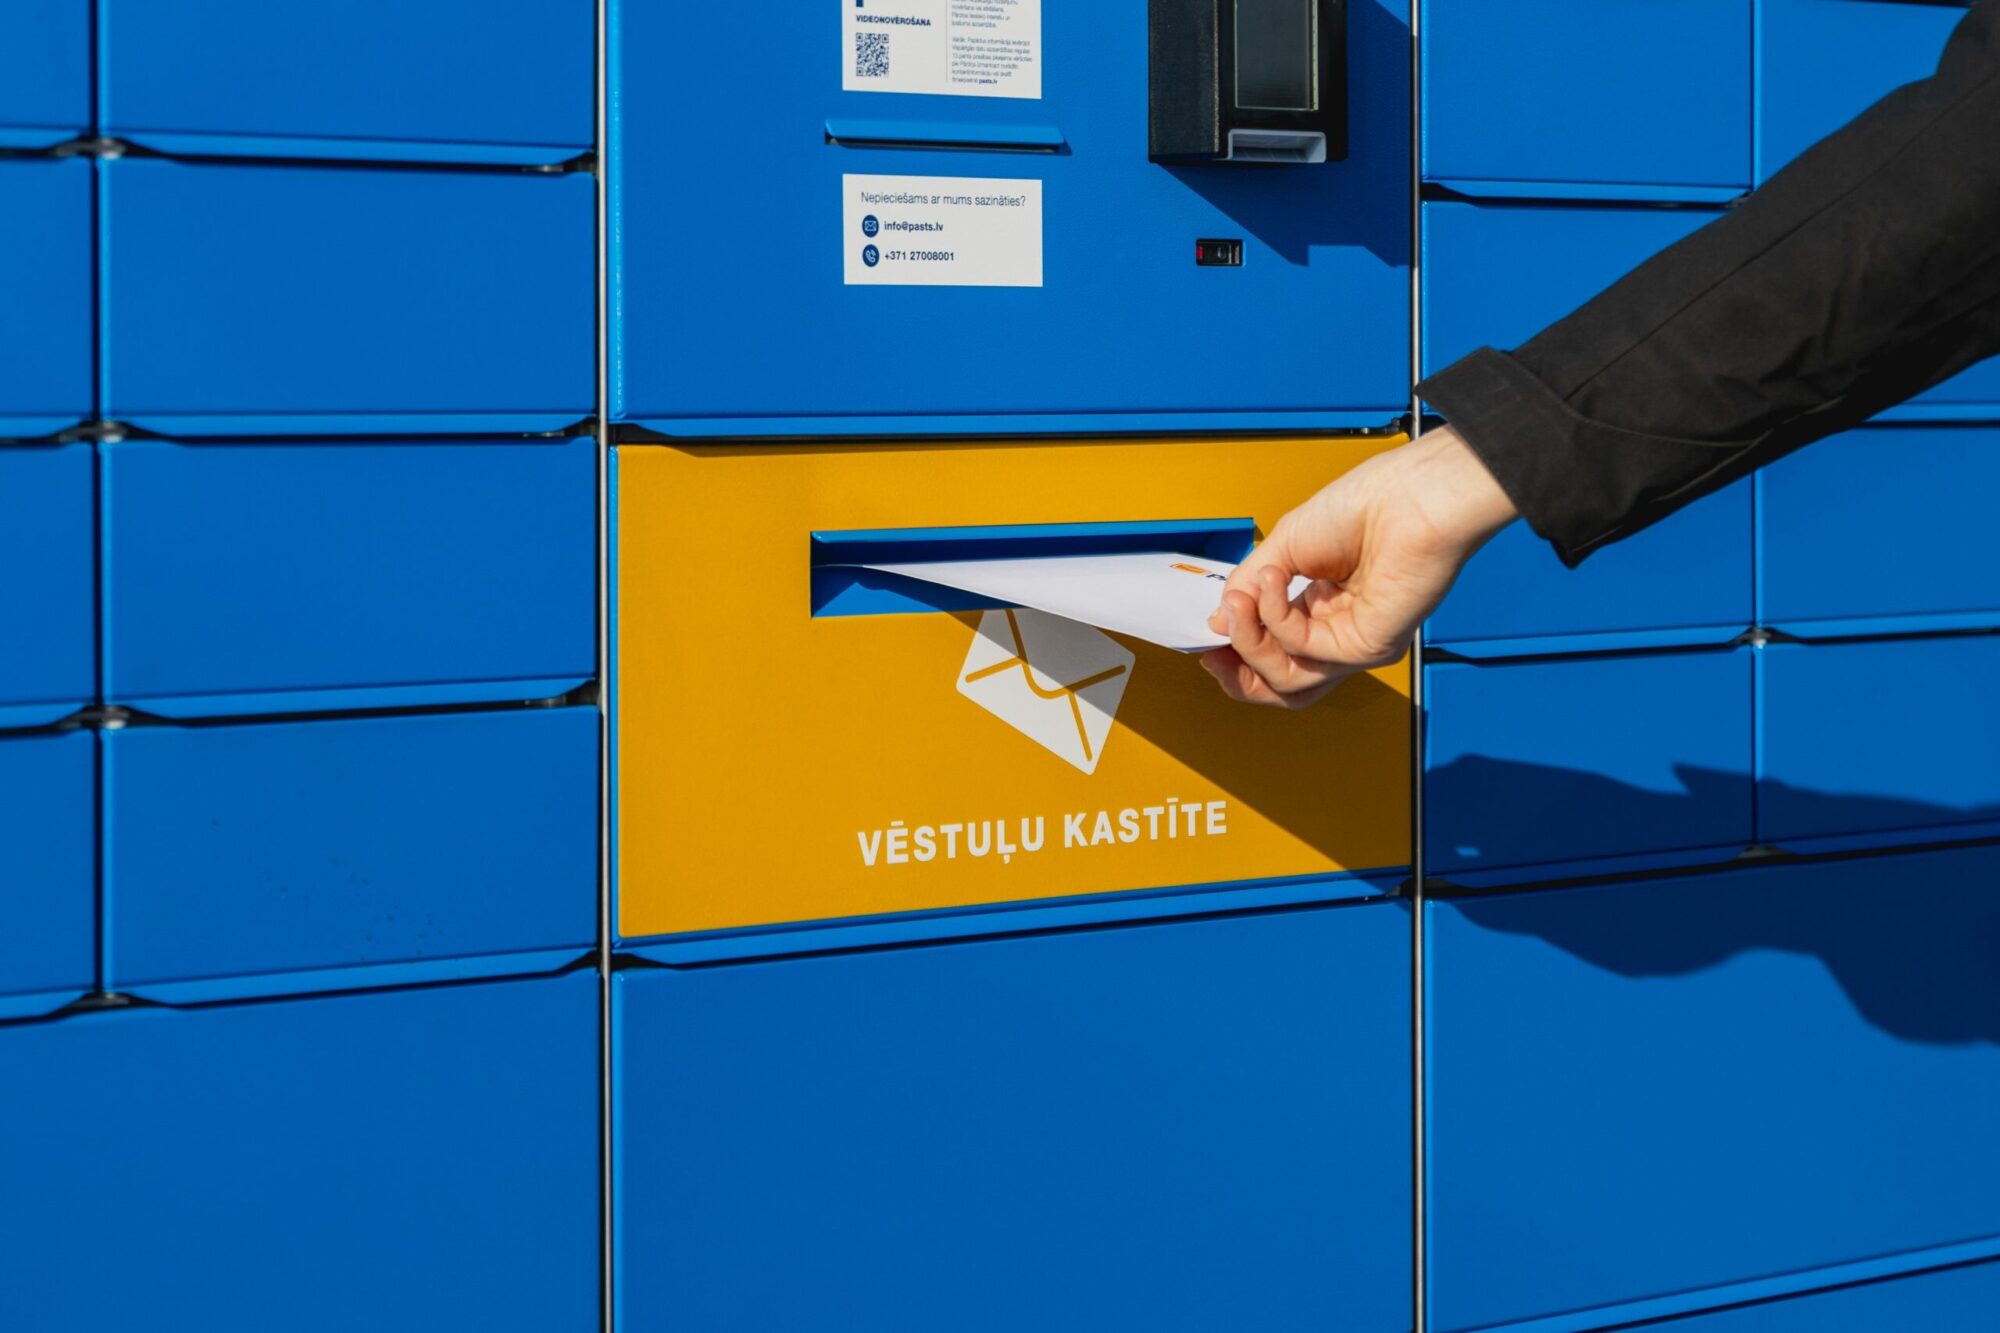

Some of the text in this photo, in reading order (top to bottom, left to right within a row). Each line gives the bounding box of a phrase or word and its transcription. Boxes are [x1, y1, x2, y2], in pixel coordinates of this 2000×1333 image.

[856, 15, 932, 26] VIDEONOVĒROŠANA
[861, 192, 1026, 207] Nepieciešams ar mums sazināties?
[884, 221, 944, 232] info@pasts.lv
[885, 251, 955, 261] +371 27008001
[857, 797, 1228, 866] VĒSTUĻU KASTĪTE
